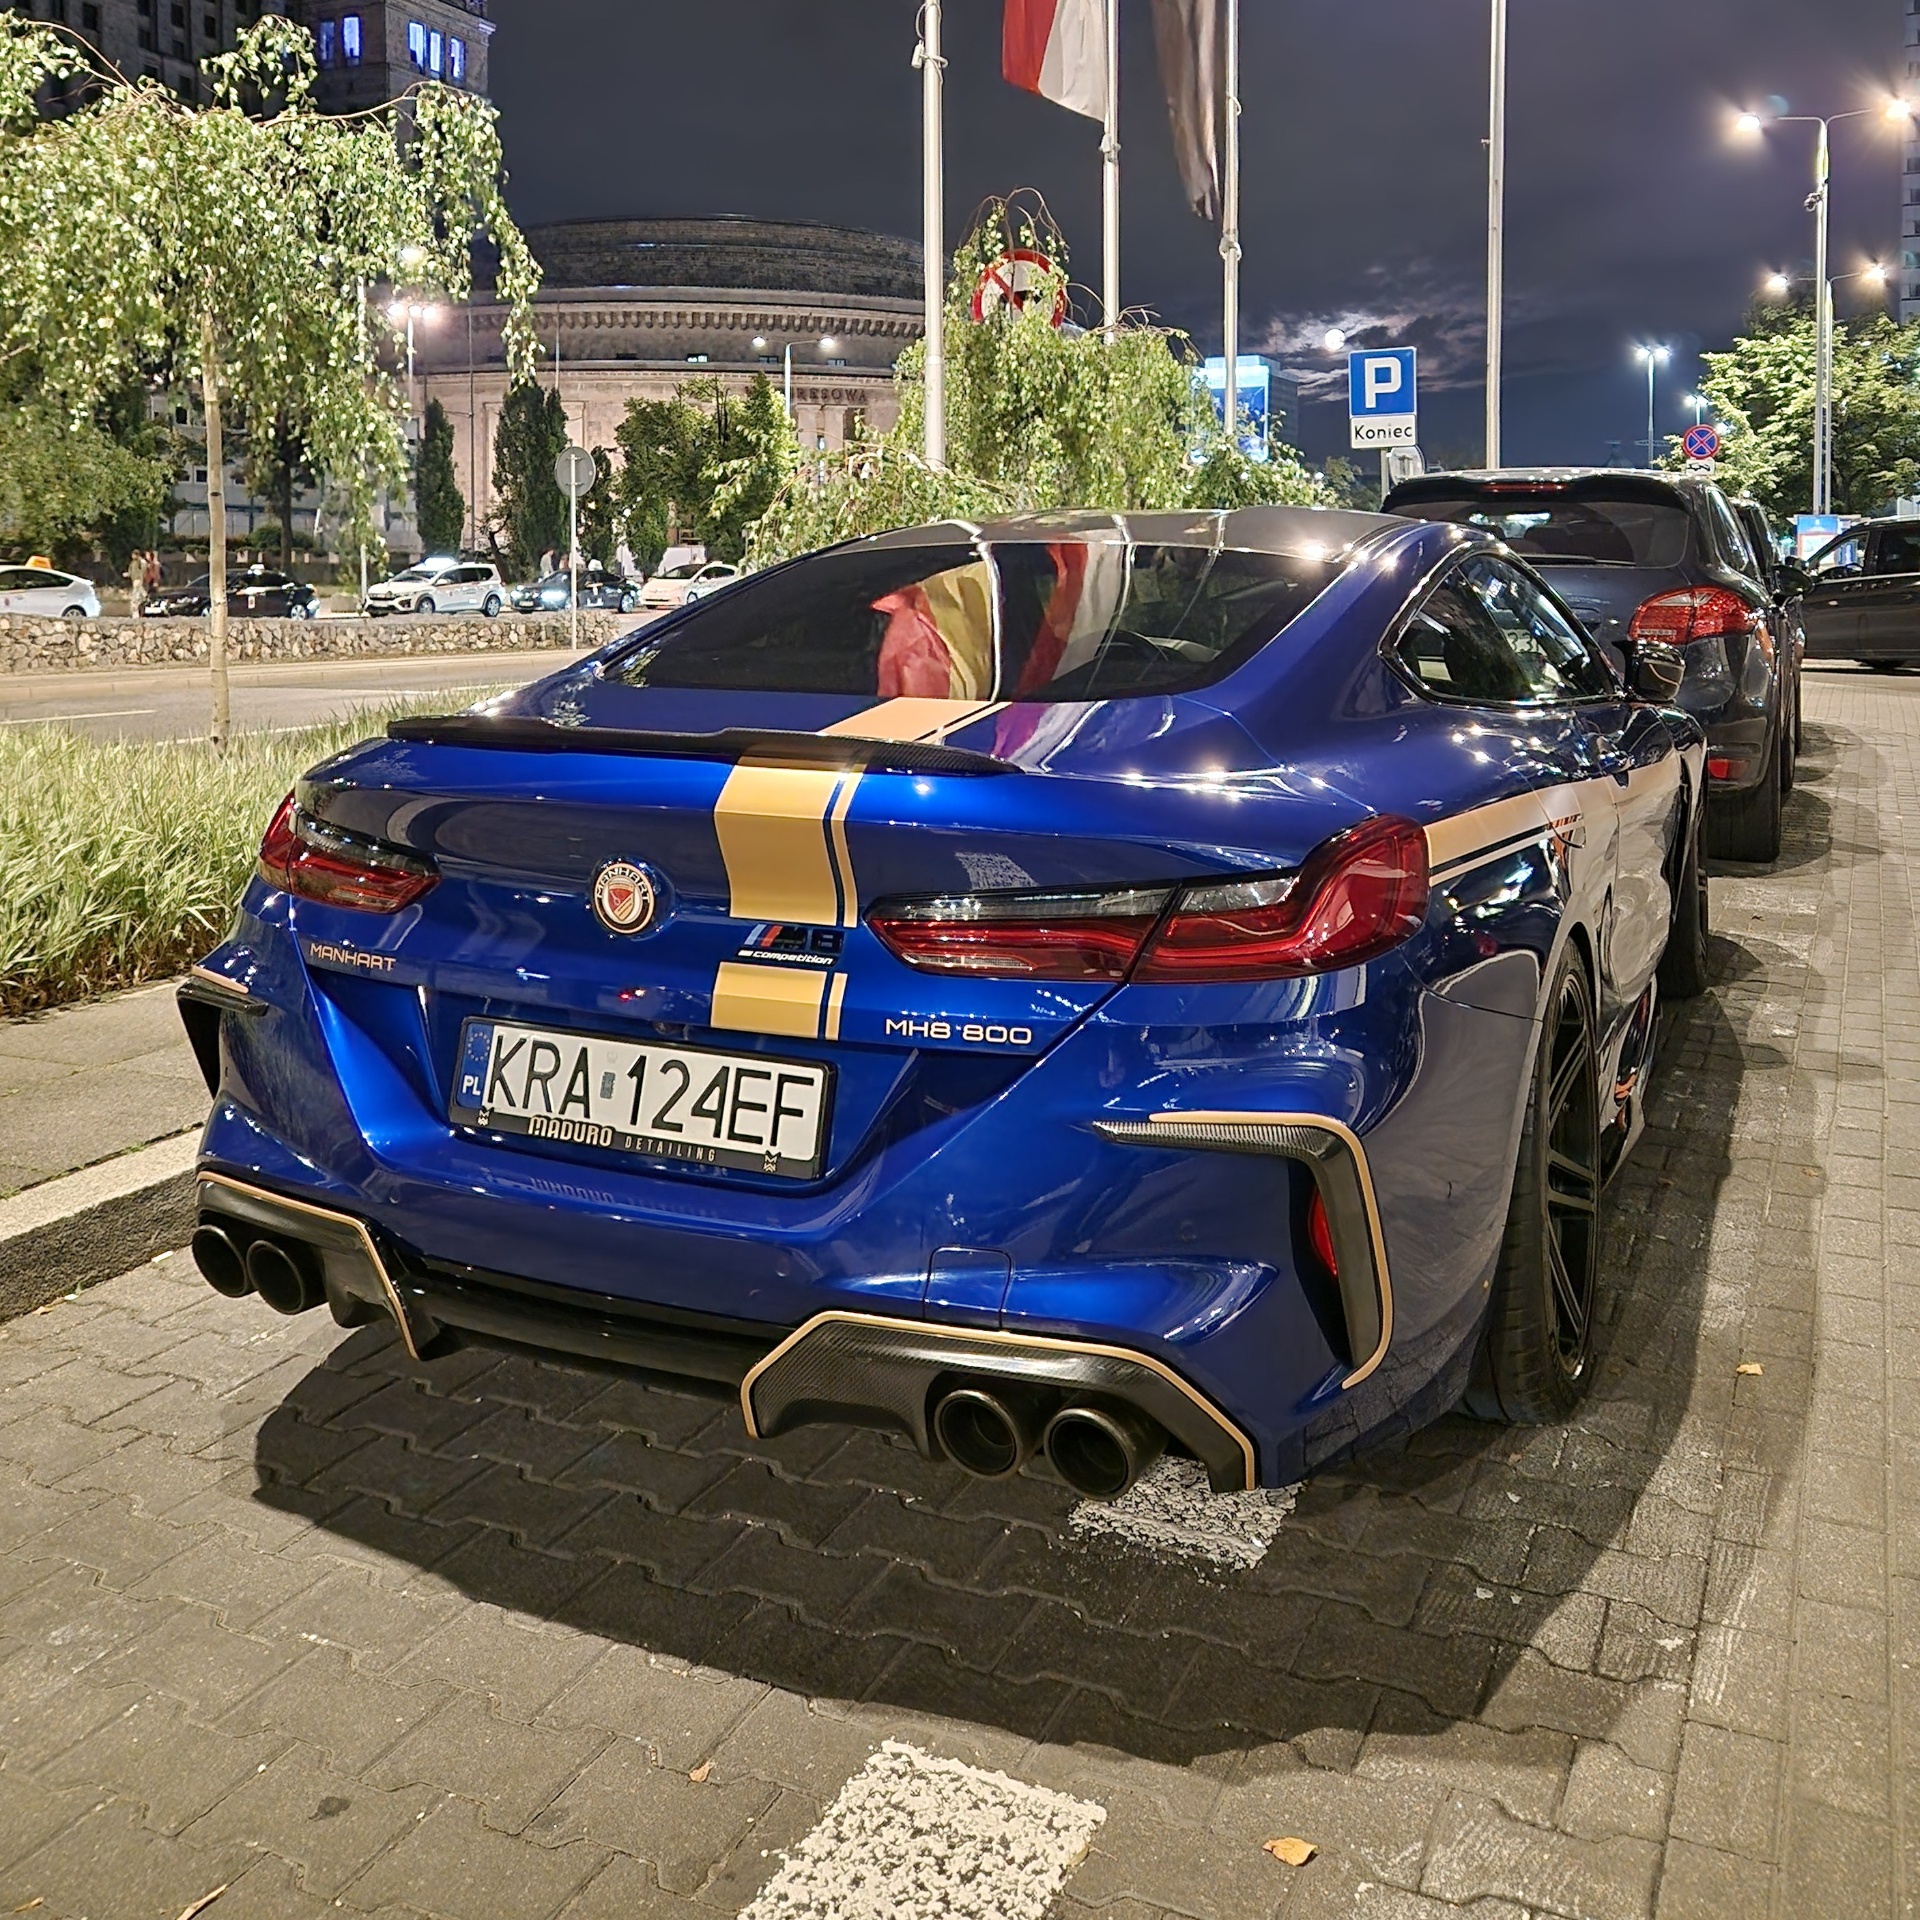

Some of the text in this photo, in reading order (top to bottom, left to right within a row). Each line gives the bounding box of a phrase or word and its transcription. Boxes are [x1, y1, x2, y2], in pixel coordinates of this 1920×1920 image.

[784, 386, 868, 403] RESOWA
[1364, 356, 1402, 409] P
[1354, 424, 1413, 440] Koniec
[596, 867, 651, 904] MANHART
[310, 943, 397, 972] MANHART
[752, 950, 834, 965] competition
[885, 1019, 1032, 1045] MH8 800
[462, 1074, 482, 1097] PL
[488, 1034, 815, 1147] KRA 124EF
[527, 1115, 717, 1163] MADURO DETAILING
